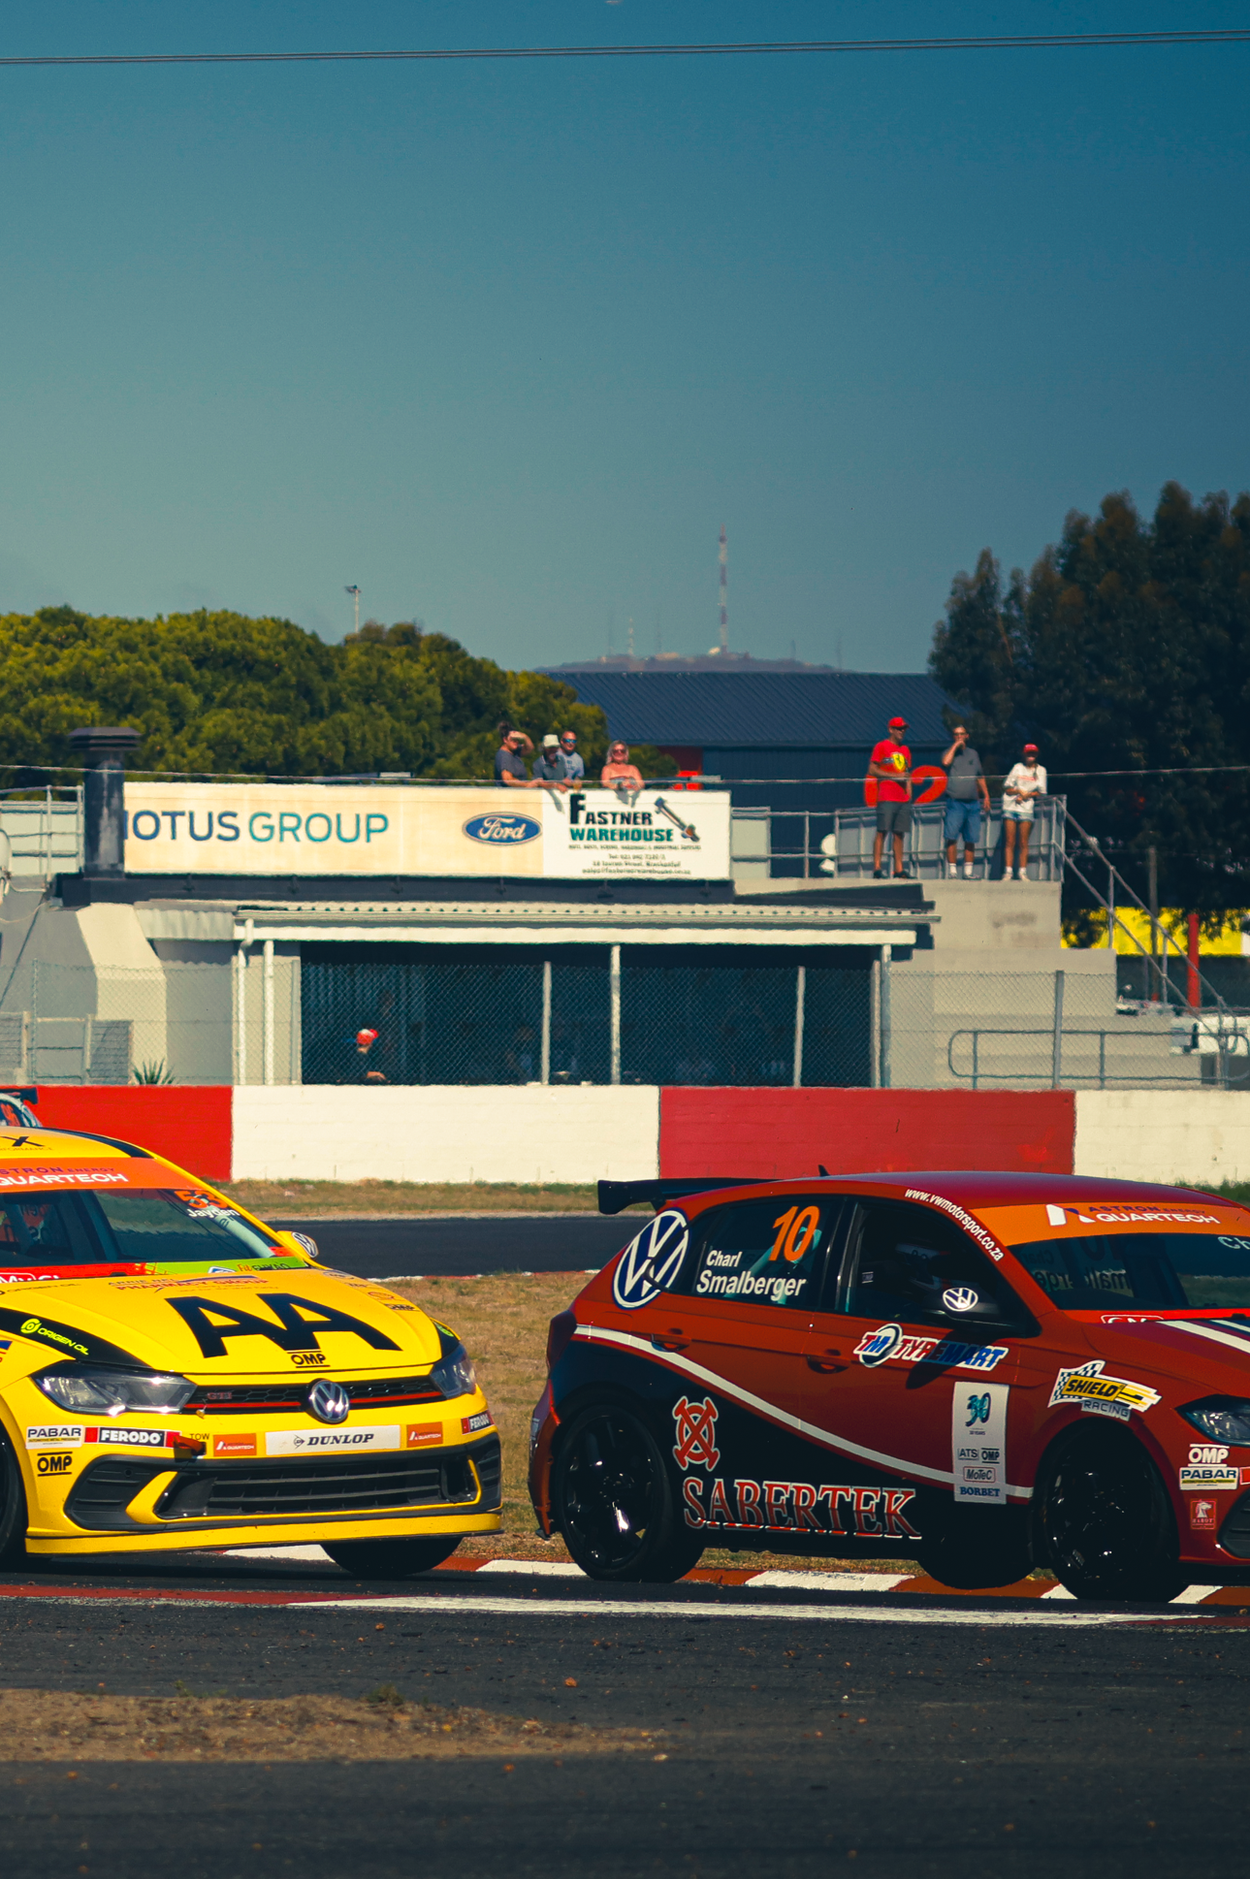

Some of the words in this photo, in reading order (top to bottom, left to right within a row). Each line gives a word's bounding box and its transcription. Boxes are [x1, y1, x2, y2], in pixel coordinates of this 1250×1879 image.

[569, 793, 653, 825] FASTNER
[249, 811, 390, 844] GROUP
[478, 816, 527, 840] Ford
[569, 828, 674, 842] WAREHOUSE
[174, 1189, 229, 1209] 53
[187, 1205, 241, 1218] Jayden
[1096, 1213, 1221, 1224] QUARTECH
[768, 1205, 820, 1262] 10
[904, 1188, 1004, 1262] www.vwmotorsport.co.za
[705, 1250, 742, 1267] Charl
[696, 1269, 807, 1302] Smalberger
[164, 1293, 403, 1359] AA
[38, 1326, 76, 1348] ORIGEN
[75, 1343, 89, 1355] OIL
[857, 1334, 891, 1353] TM
[291, 1352, 326, 1365] OMP
[896, 1337, 1007, 1369] TYREMART
[207, 1391, 233, 1400] GTI
[1065, 1379, 1119, 1397] SHIELD
[1083, 1400, 1129, 1418] RACING
[27, 1427, 82, 1438] PABAR
[101, 1429, 161, 1444] FERODO
[306, 1433, 374, 1446] DUNLOP
[959, 1448, 978, 1459] ATS
[981, 1450, 1000, 1461] OMP
[1188, 1447, 1229, 1463] OMP
[37, 1455, 72, 1472] OMP
[966, 1468, 993, 1481] MoTeC
[1181, 1469, 1237, 1479] PABAR
[959, 1486, 1000, 1498] BORBET
[682, 1476, 922, 1539] SABERTEK
